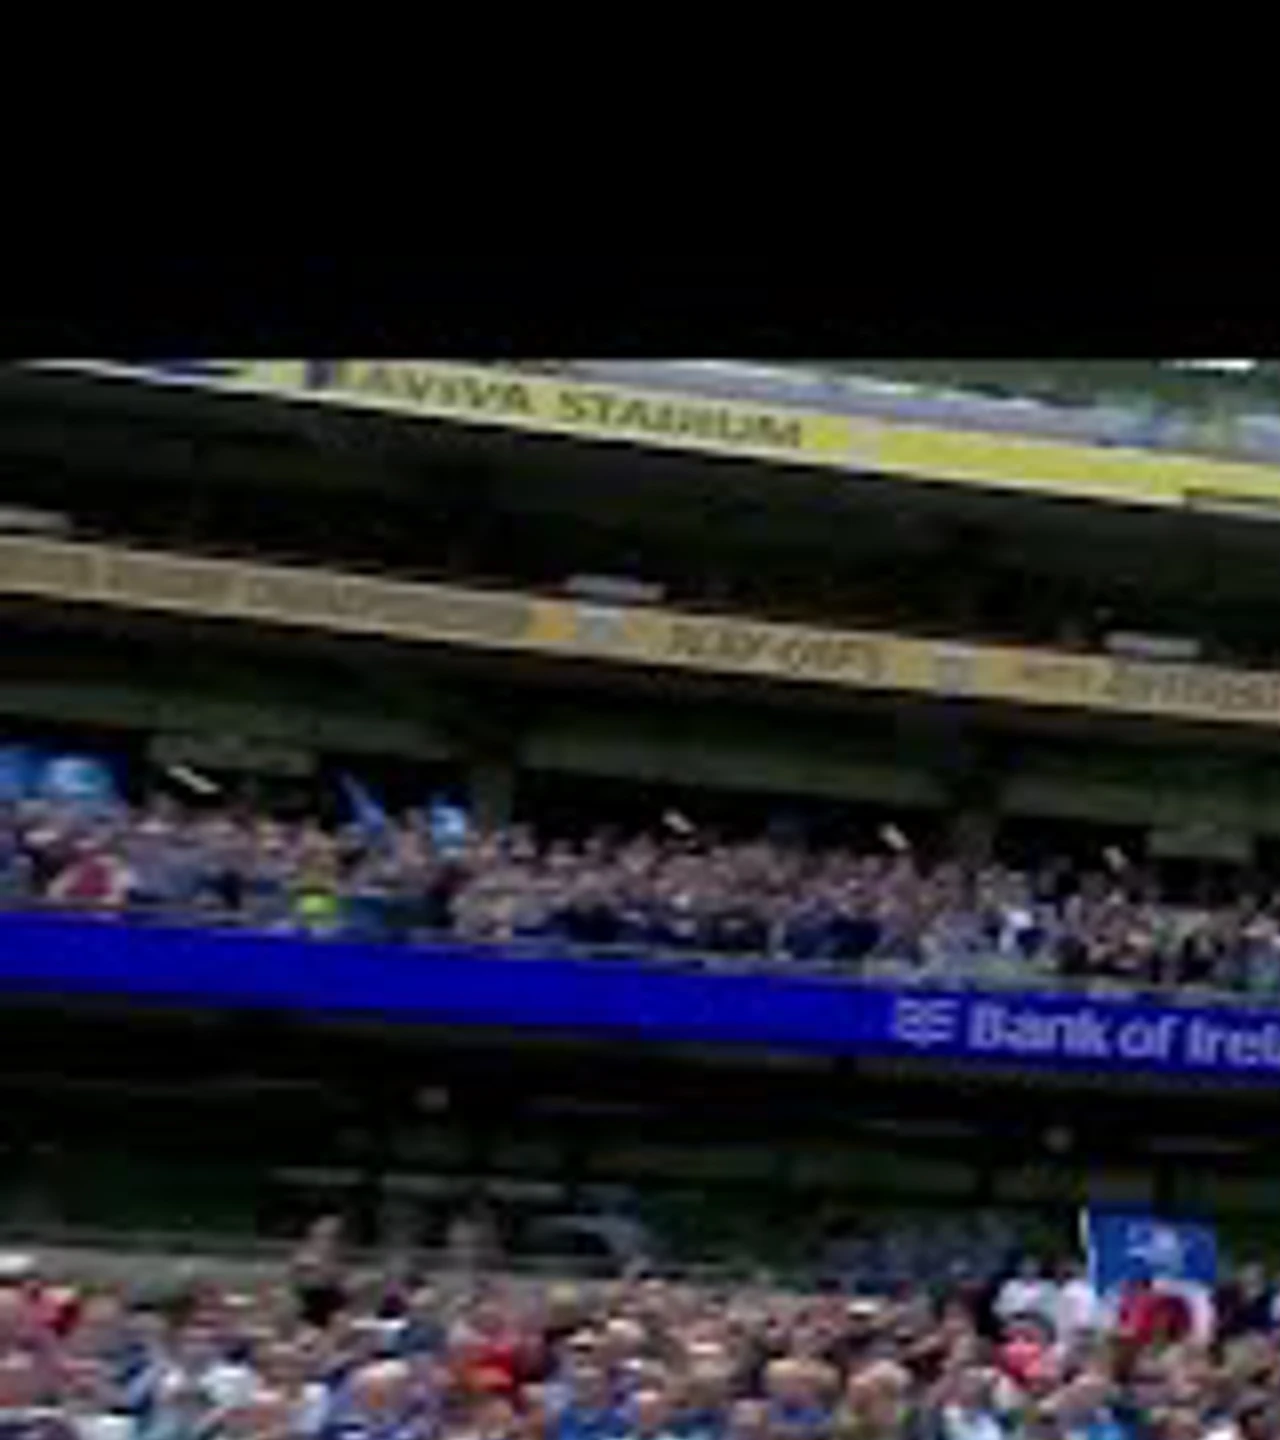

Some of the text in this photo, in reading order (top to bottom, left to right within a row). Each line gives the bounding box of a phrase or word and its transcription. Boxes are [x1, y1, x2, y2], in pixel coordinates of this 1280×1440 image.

[555, 388, 802, 449] STADIUM
[967, 1001, 1108, 1060] Bank
[1117, 1013, 1181, 1061] of
